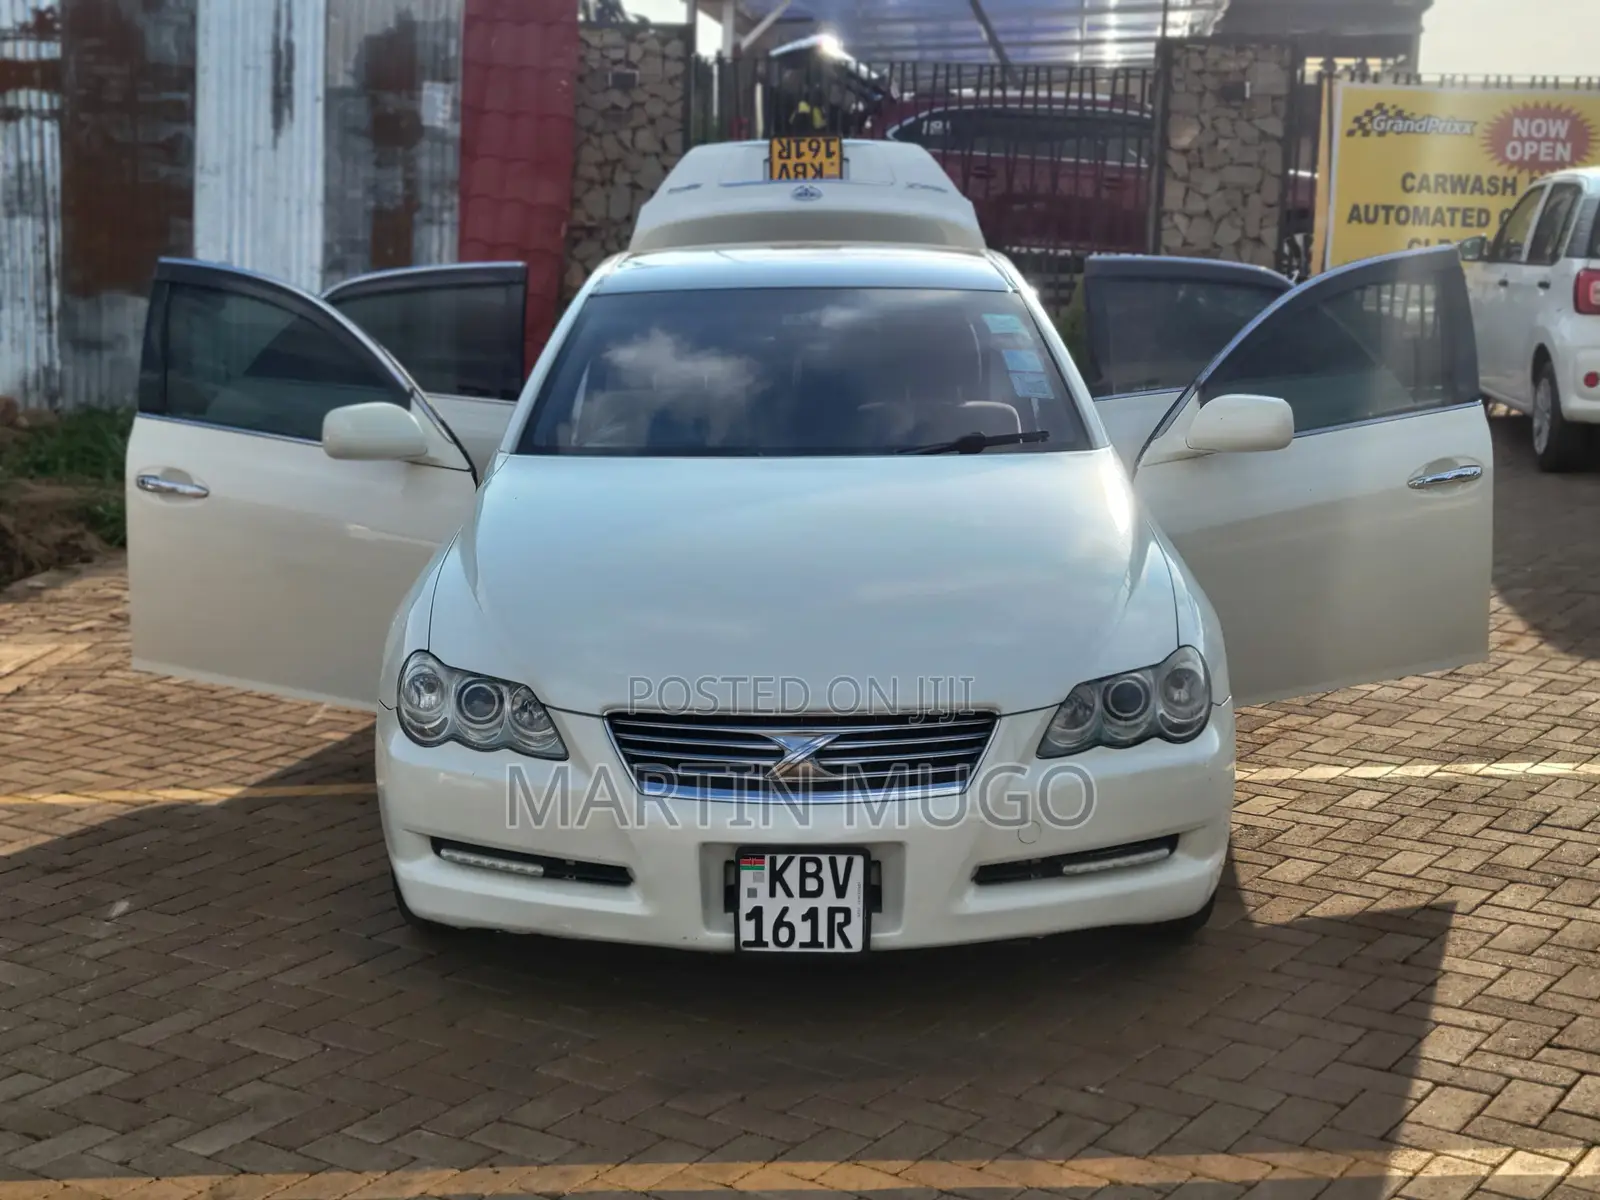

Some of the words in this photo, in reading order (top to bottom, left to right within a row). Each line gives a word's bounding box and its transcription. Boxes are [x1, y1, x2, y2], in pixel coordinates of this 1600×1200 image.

[1512, 117, 1570, 139] NOW
[777, 138, 837, 159] 161R
[1505, 140, 1573, 162] OPEN
[778, 162, 823, 180] KBV
[1401, 172, 1517, 196] CARWASH
[1347, 204, 1490, 228] AUTOMATED
[769, 855, 854, 899] KBV
[742, 905, 853, 949] 161R
